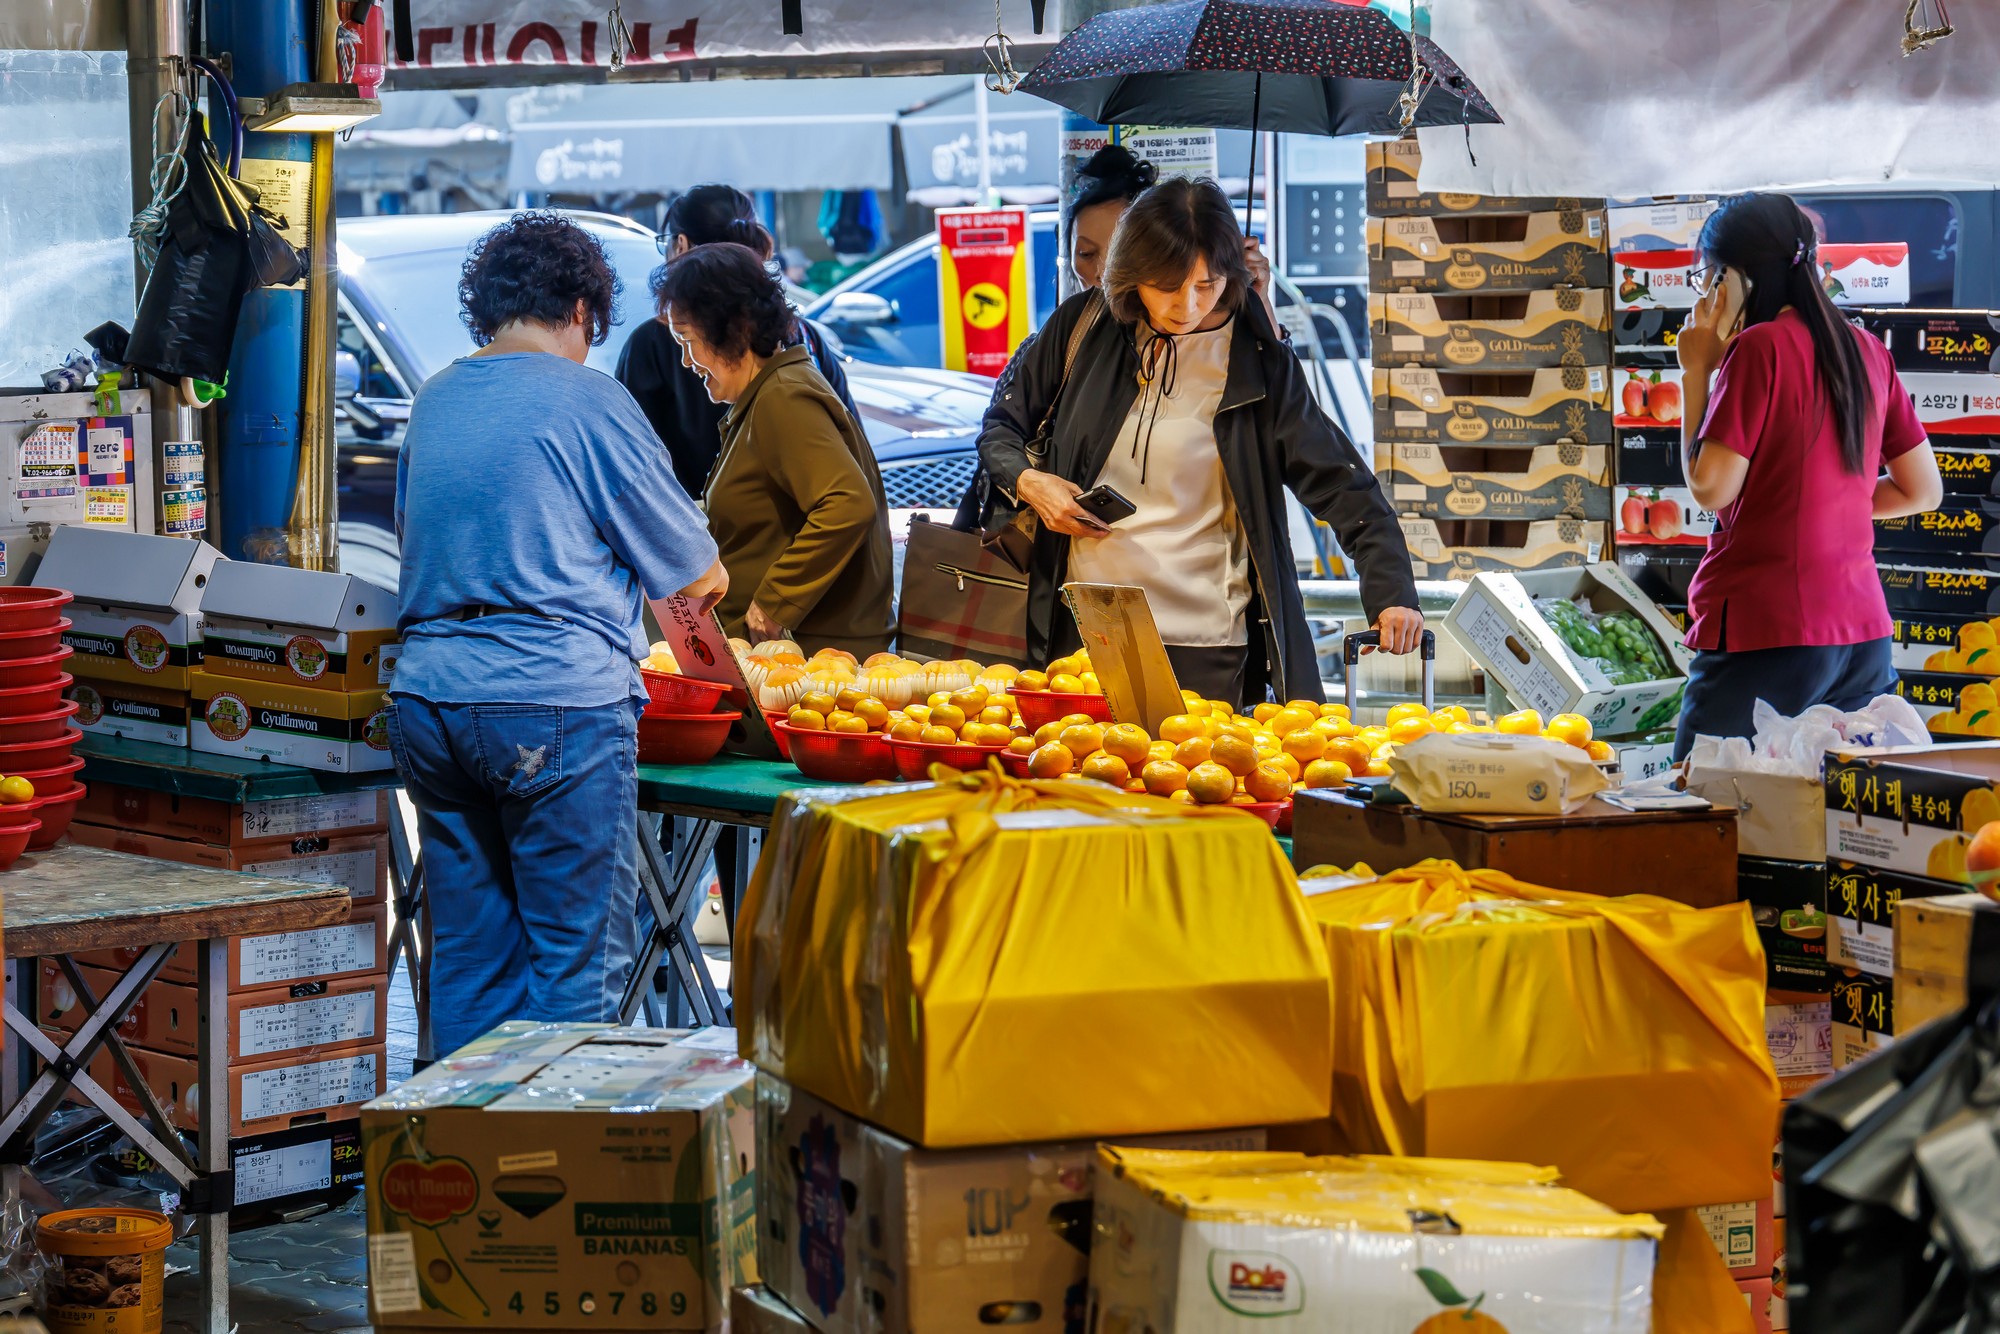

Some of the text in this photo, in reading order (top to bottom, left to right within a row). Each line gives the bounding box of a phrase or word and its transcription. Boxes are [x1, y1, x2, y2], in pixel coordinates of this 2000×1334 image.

[1490, 264, 1524, 276] GOLD
[1489, 339, 1522, 352] GOLD
[1922, 394, 1958, 409] 소양강
[1492, 418, 1526, 430] GOLD
[1490, 491, 1523, 504] GOLD
[1910, 624, 1952, 642] 복숭아
[62, 636, 115, 654] Gyullimwon
[226, 644, 276, 663] Gyullimwon
[1912, 685, 1954, 703] 복숭아
[112, 700, 160, 718] Gyullimwon
[261, 712, 318, 732] Gyullimwon
[326, 752, 342, 766] 5kg
[1840, 772, 1952, 823] 햇사레 복숭아
[250, 1154, 272, 1166] 정성구
[320, 1176, 330, 1186] 13
[390, 1176, 472, 1198] Del Monte
[582, 1212, 672, 1230] Premium
[584, 1238, 688, 1256] BANANAS
[1734, 1240, 1748, 1248] GAP
[1229, 1262, 1287, 1286] Dole
[508, 1291, 524, 1316] 4
[544, 1291, 560, 1316] 5
[608, 1292, 626, 1316] 7
[640, 1292, 658, 1316] 8
[670, 1292, 687, 1316] 9
